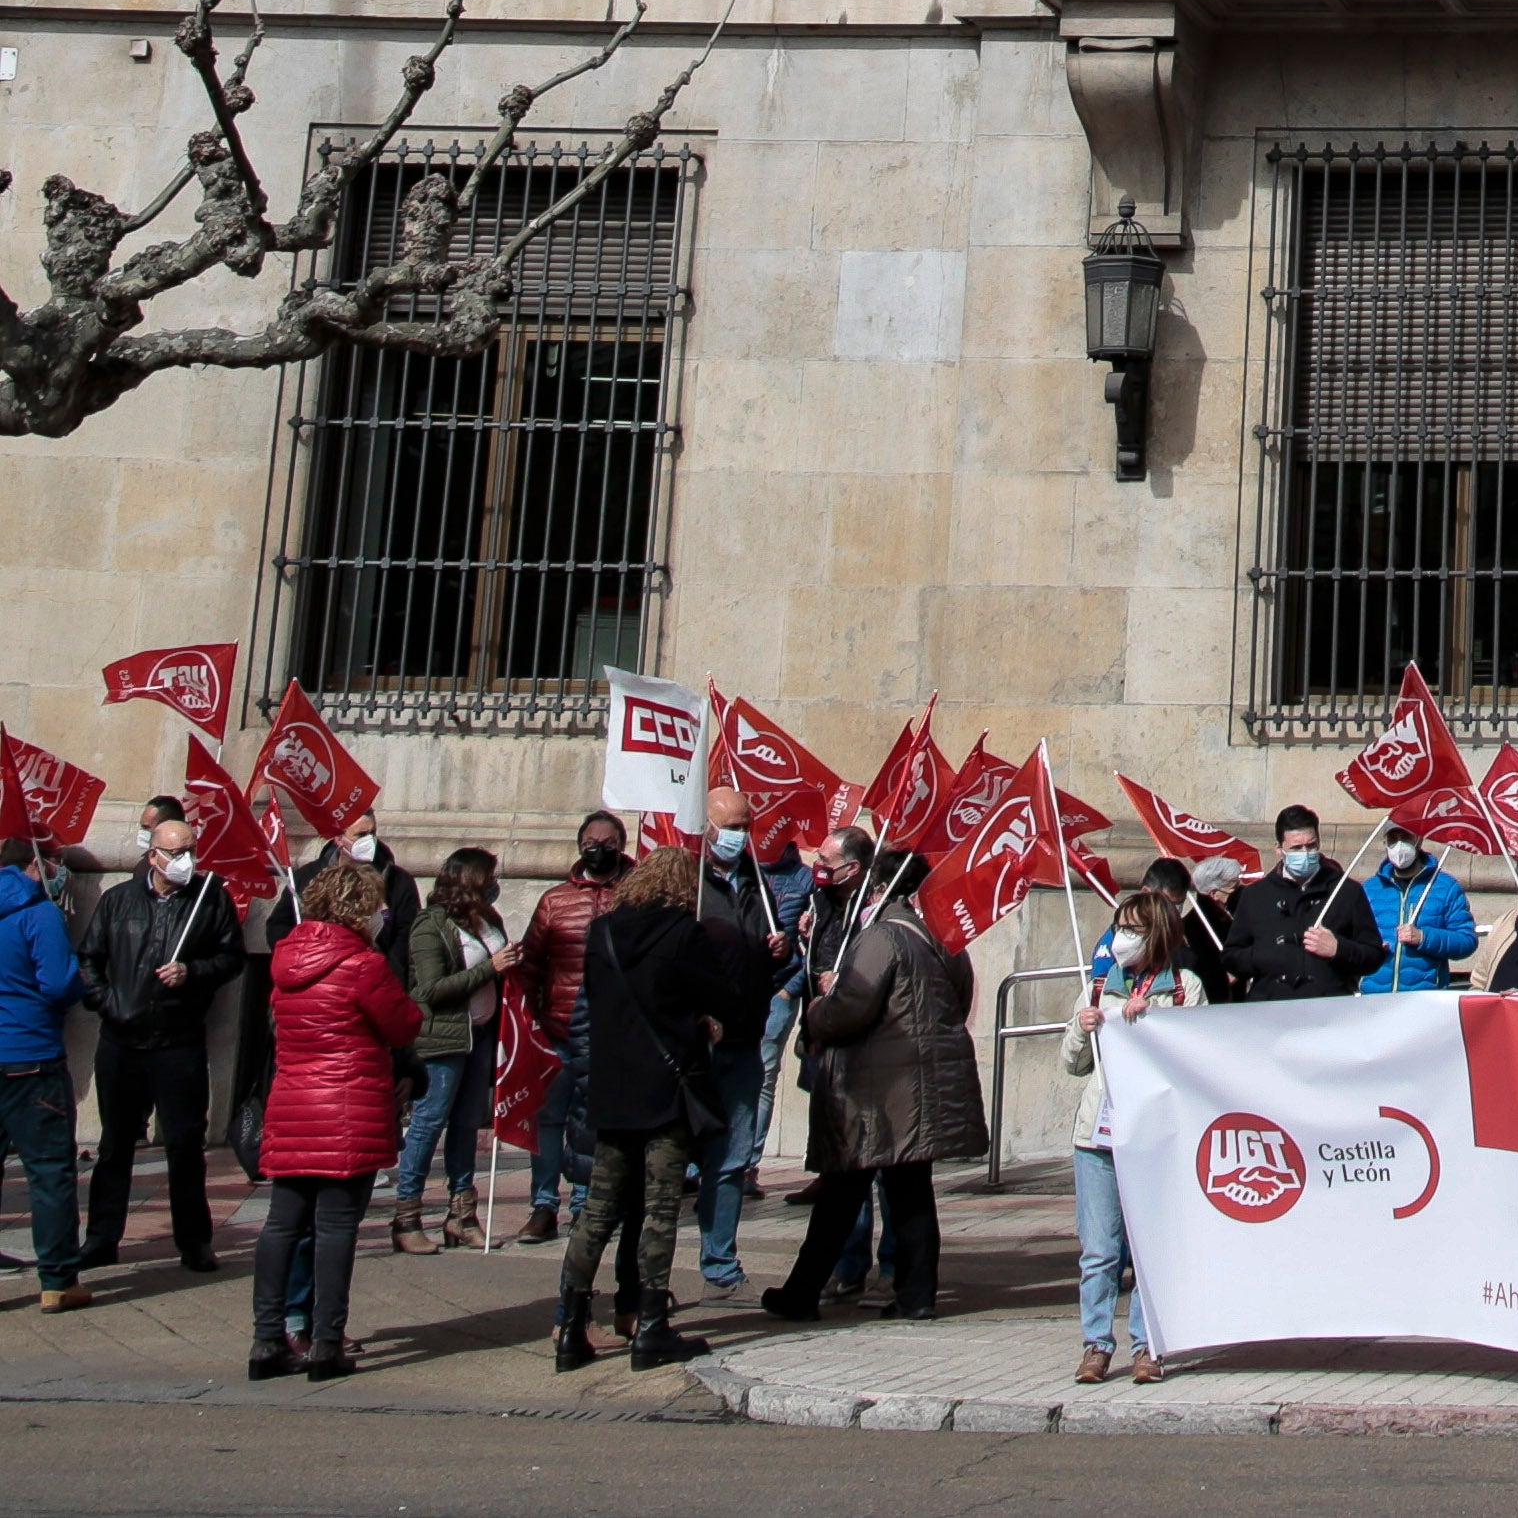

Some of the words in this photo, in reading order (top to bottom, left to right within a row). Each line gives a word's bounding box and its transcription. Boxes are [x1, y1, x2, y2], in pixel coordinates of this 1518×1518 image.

[1210, 1129, 1290, 1172] UGT
[1318, 1140, 1396, 1162] Castilla
[1322, 1169, 1334, 1188] y
[1342, 1162, 1391, 1183] León
